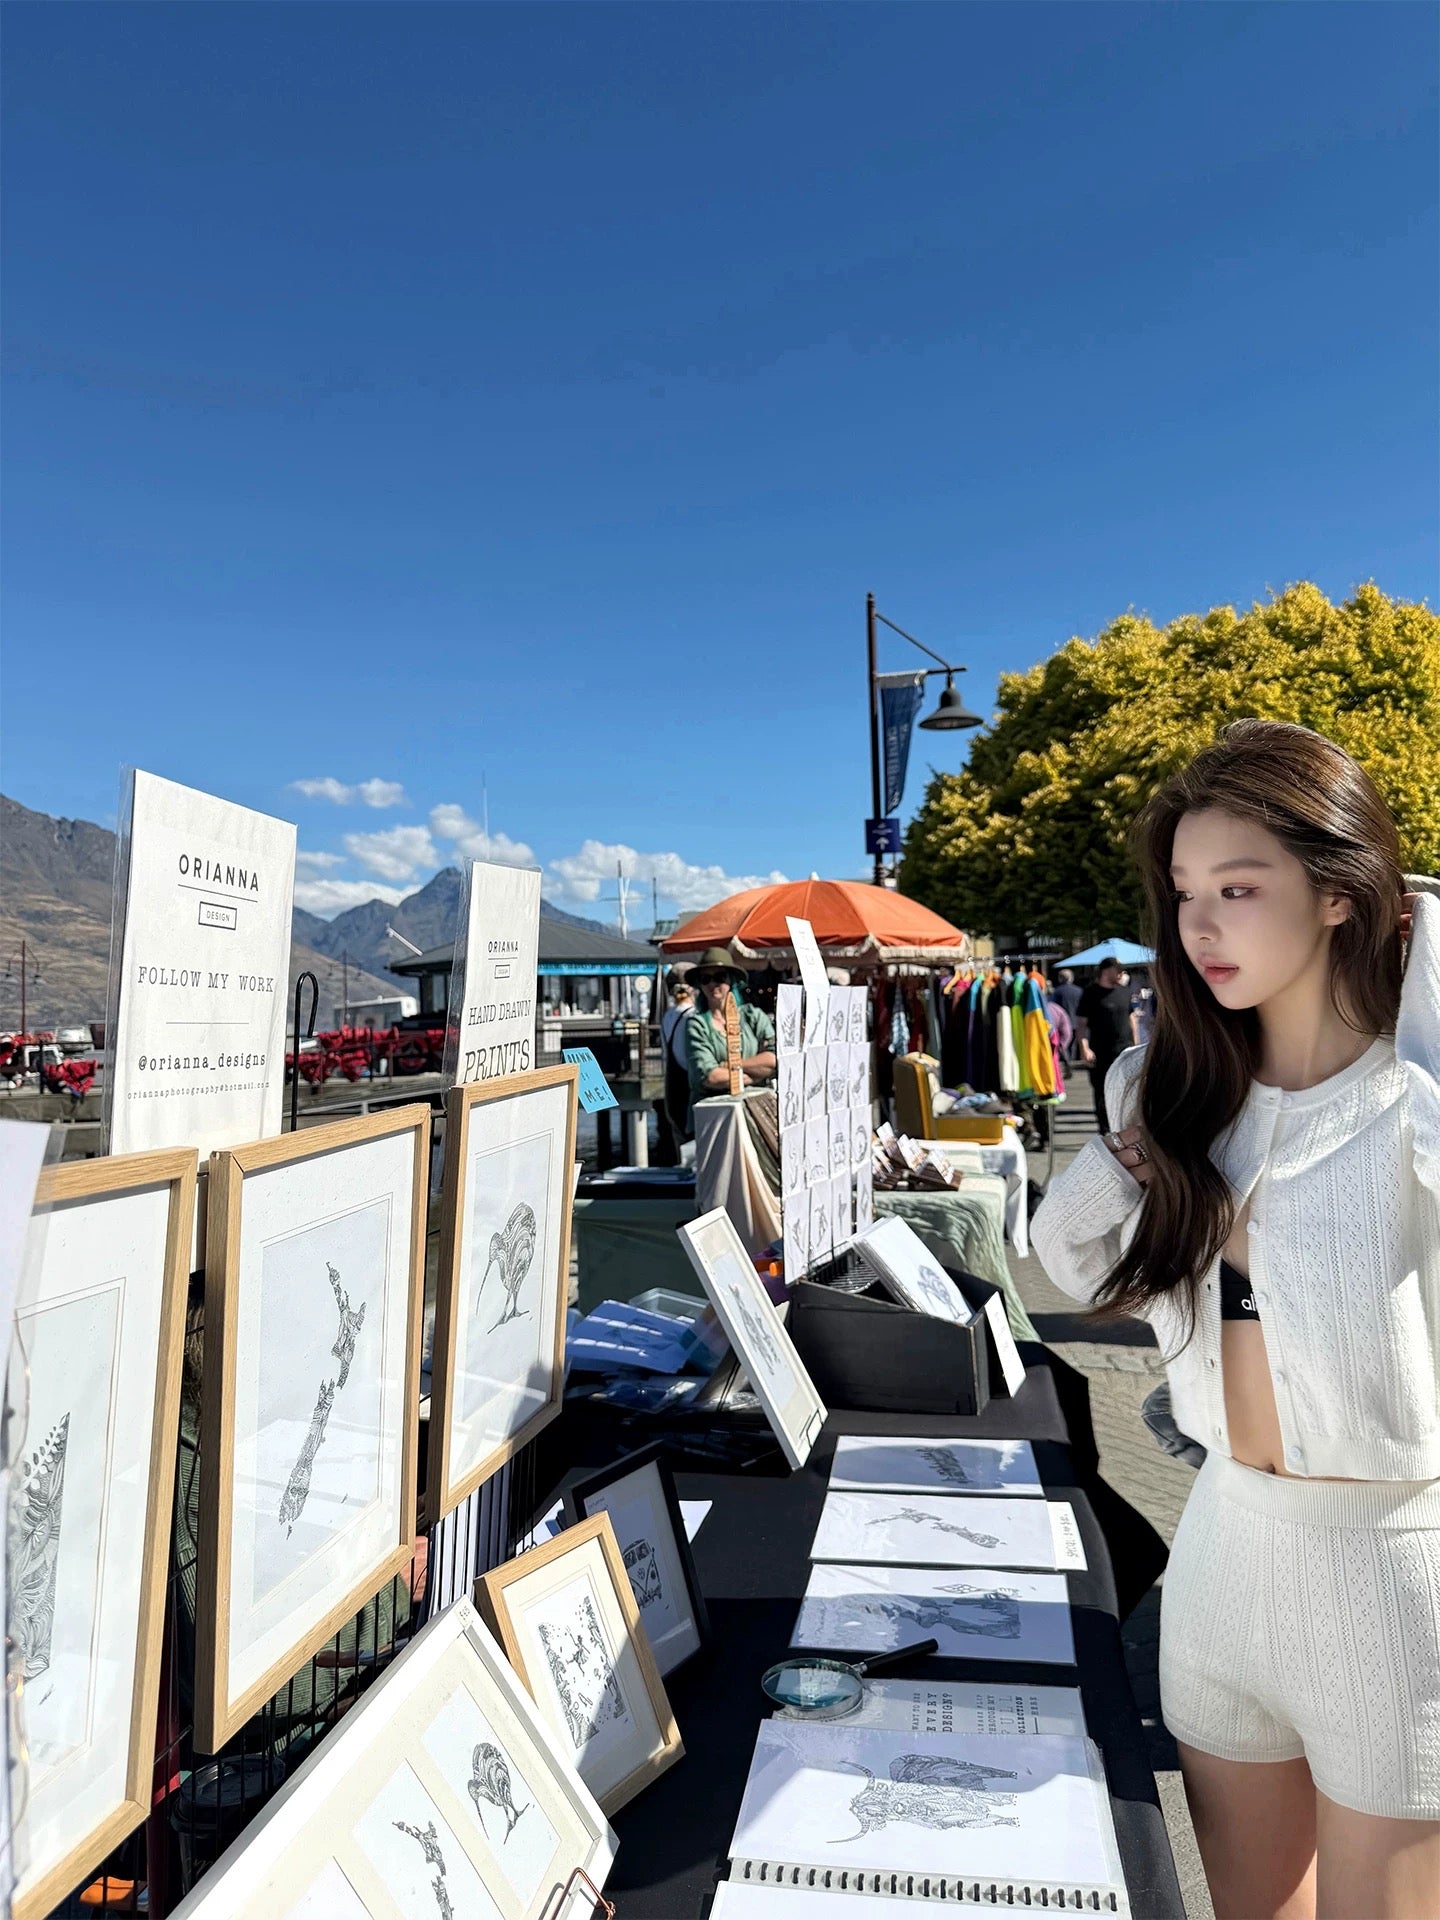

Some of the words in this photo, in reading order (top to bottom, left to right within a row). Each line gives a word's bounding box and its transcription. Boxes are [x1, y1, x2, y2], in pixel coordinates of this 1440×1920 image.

[179, 854, 259, 892] ORIANNA
[206, 910, 230, 922] DESIGN
[488, 941, 518, 953] ORIANNA
[138, 966, 202, 988] FOLLOW
[208, 972, 229, 989] MY
[239, 975, 274, 993] WORK
[468, 1004, 497, 1026] HAND
[498, 999, 531, 1021] DRAWN
[138, 1052, 266, 1071] @orianna_designs
[462, 1038, 530, 1084] PRINTS
[926, 1692, 937, 1733] EVERY
[942, 1692, 953, 1733] DESIGN?
[1015, 1696, 1026, 1734] OLLECTION
